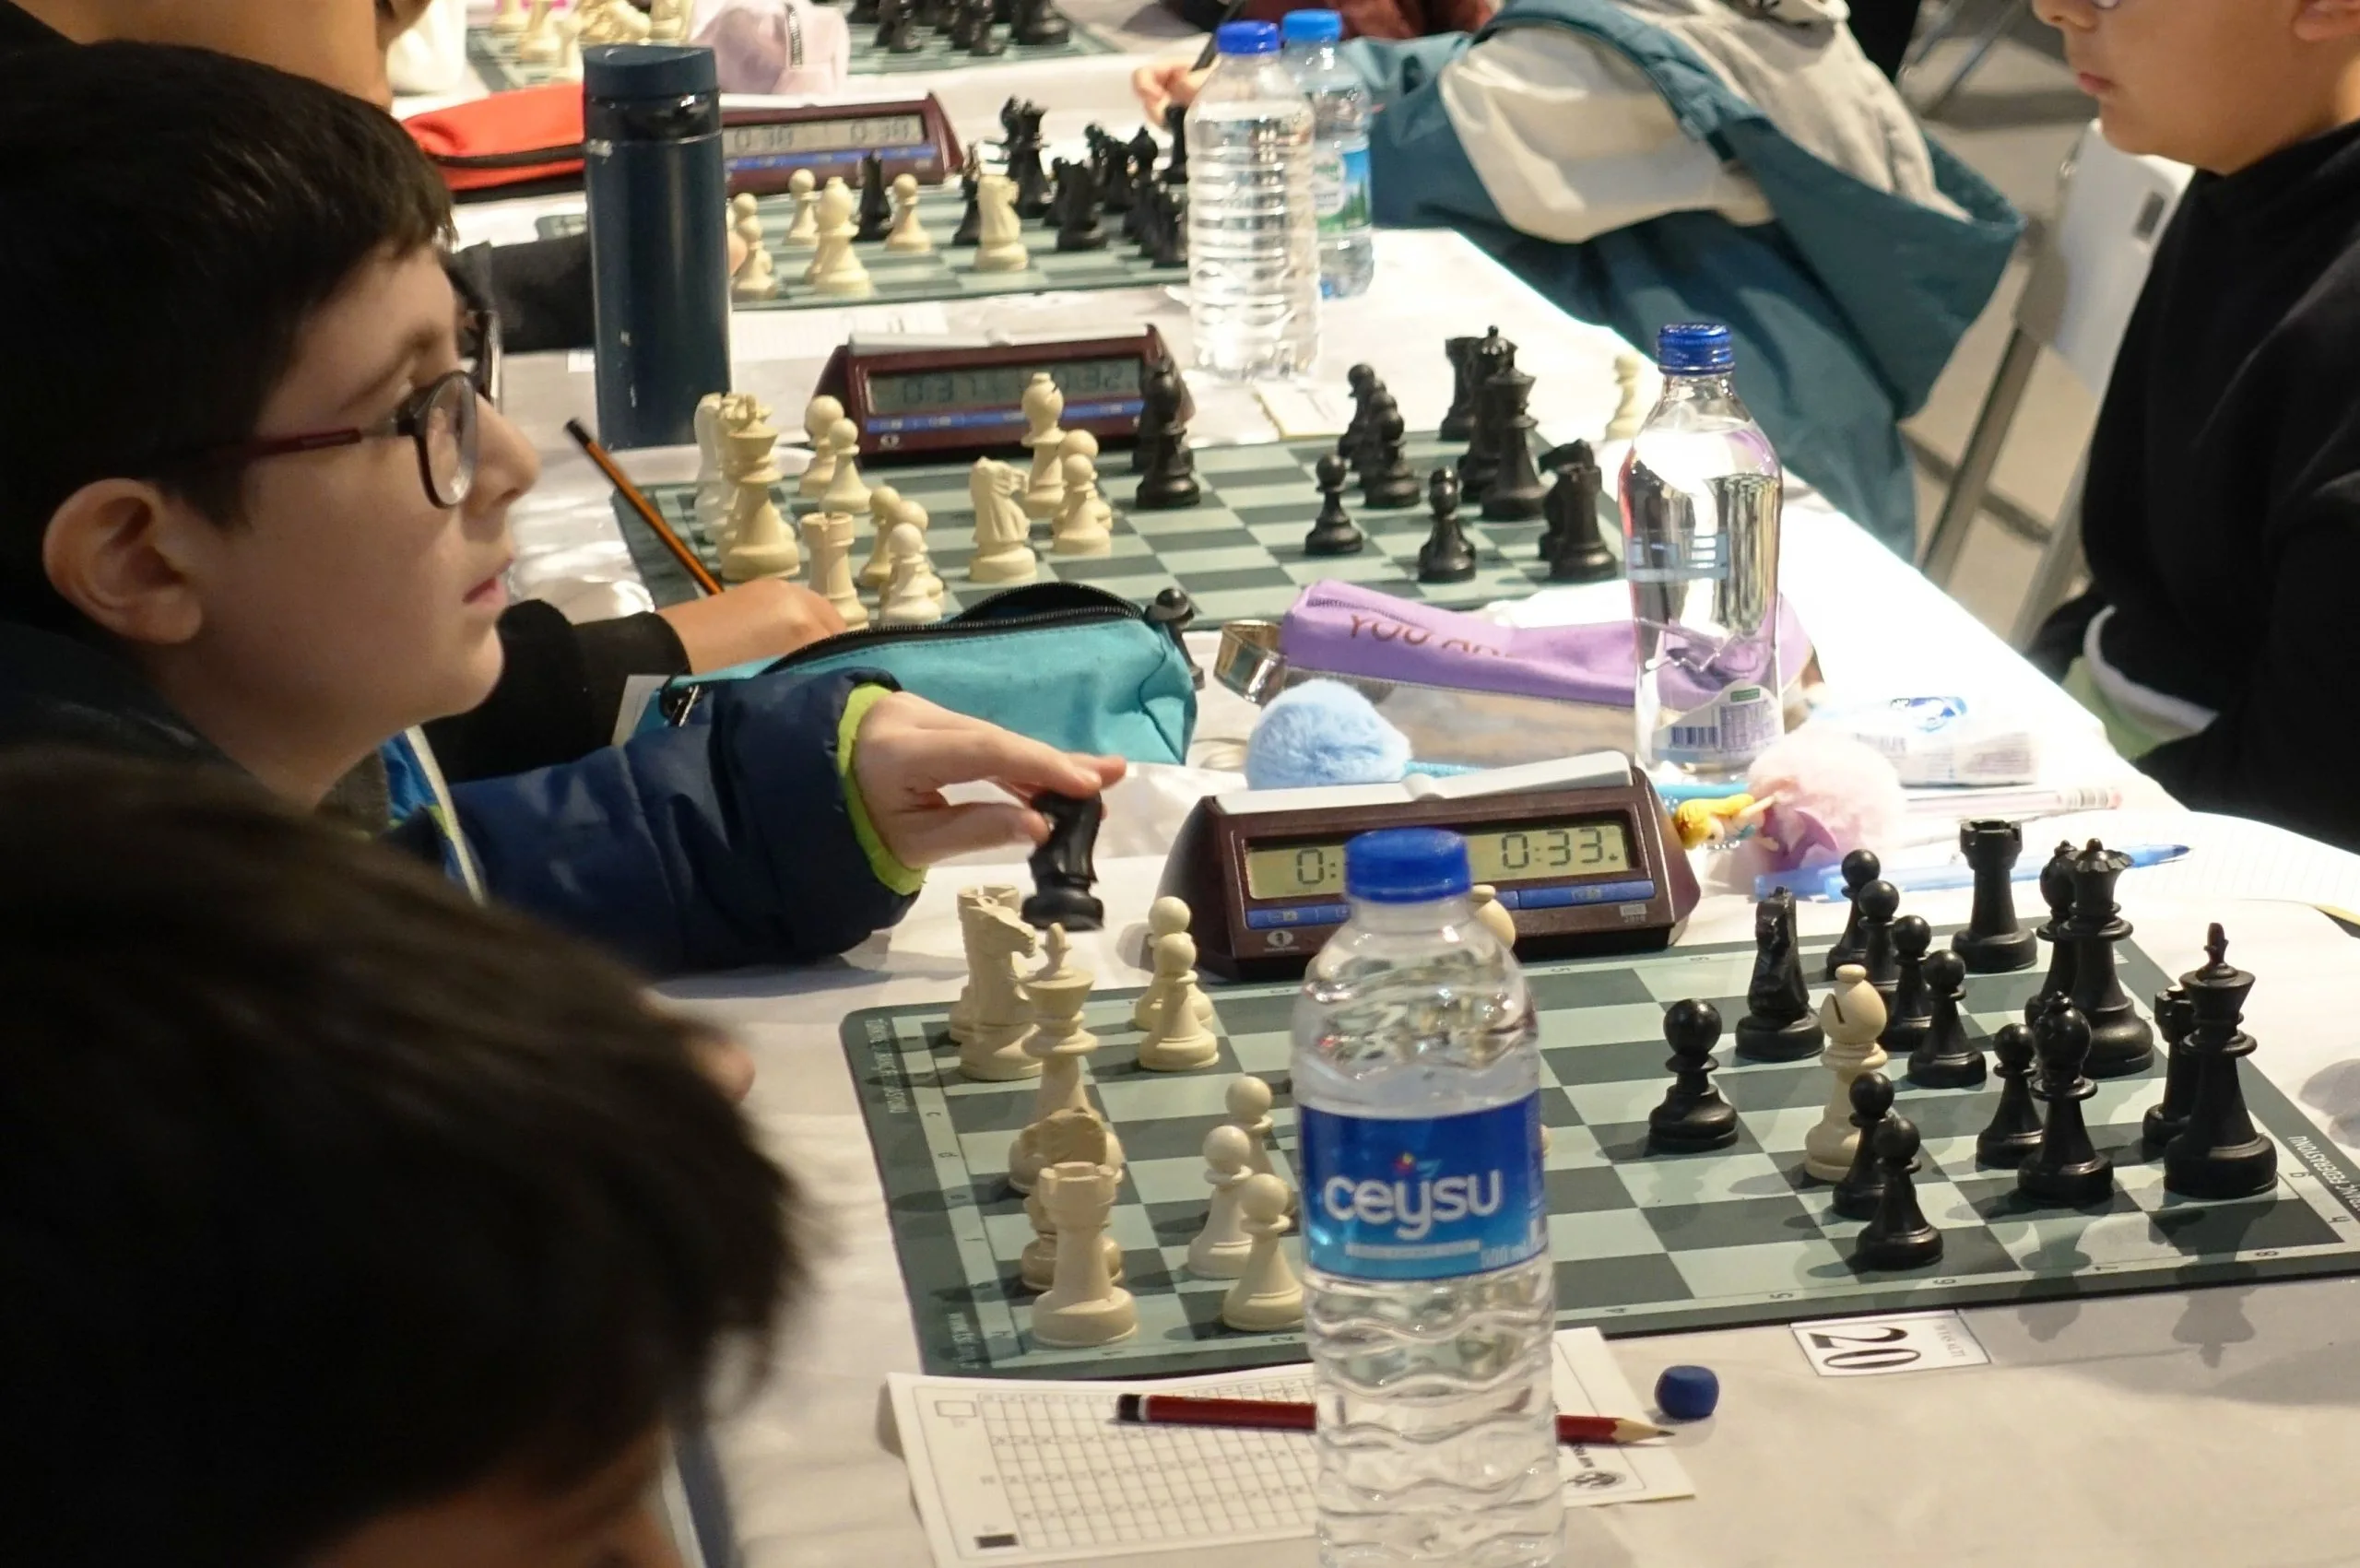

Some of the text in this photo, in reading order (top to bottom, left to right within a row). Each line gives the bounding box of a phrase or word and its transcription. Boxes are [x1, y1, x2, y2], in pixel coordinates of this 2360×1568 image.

[1296, 847, 1337, 885] 0:
[2287, 1136, 2351, 1185] FEDERASYONU
[1325, 1169, 1502, 1240] ceysu
[1808, 1326, 1922, 1370] 20
